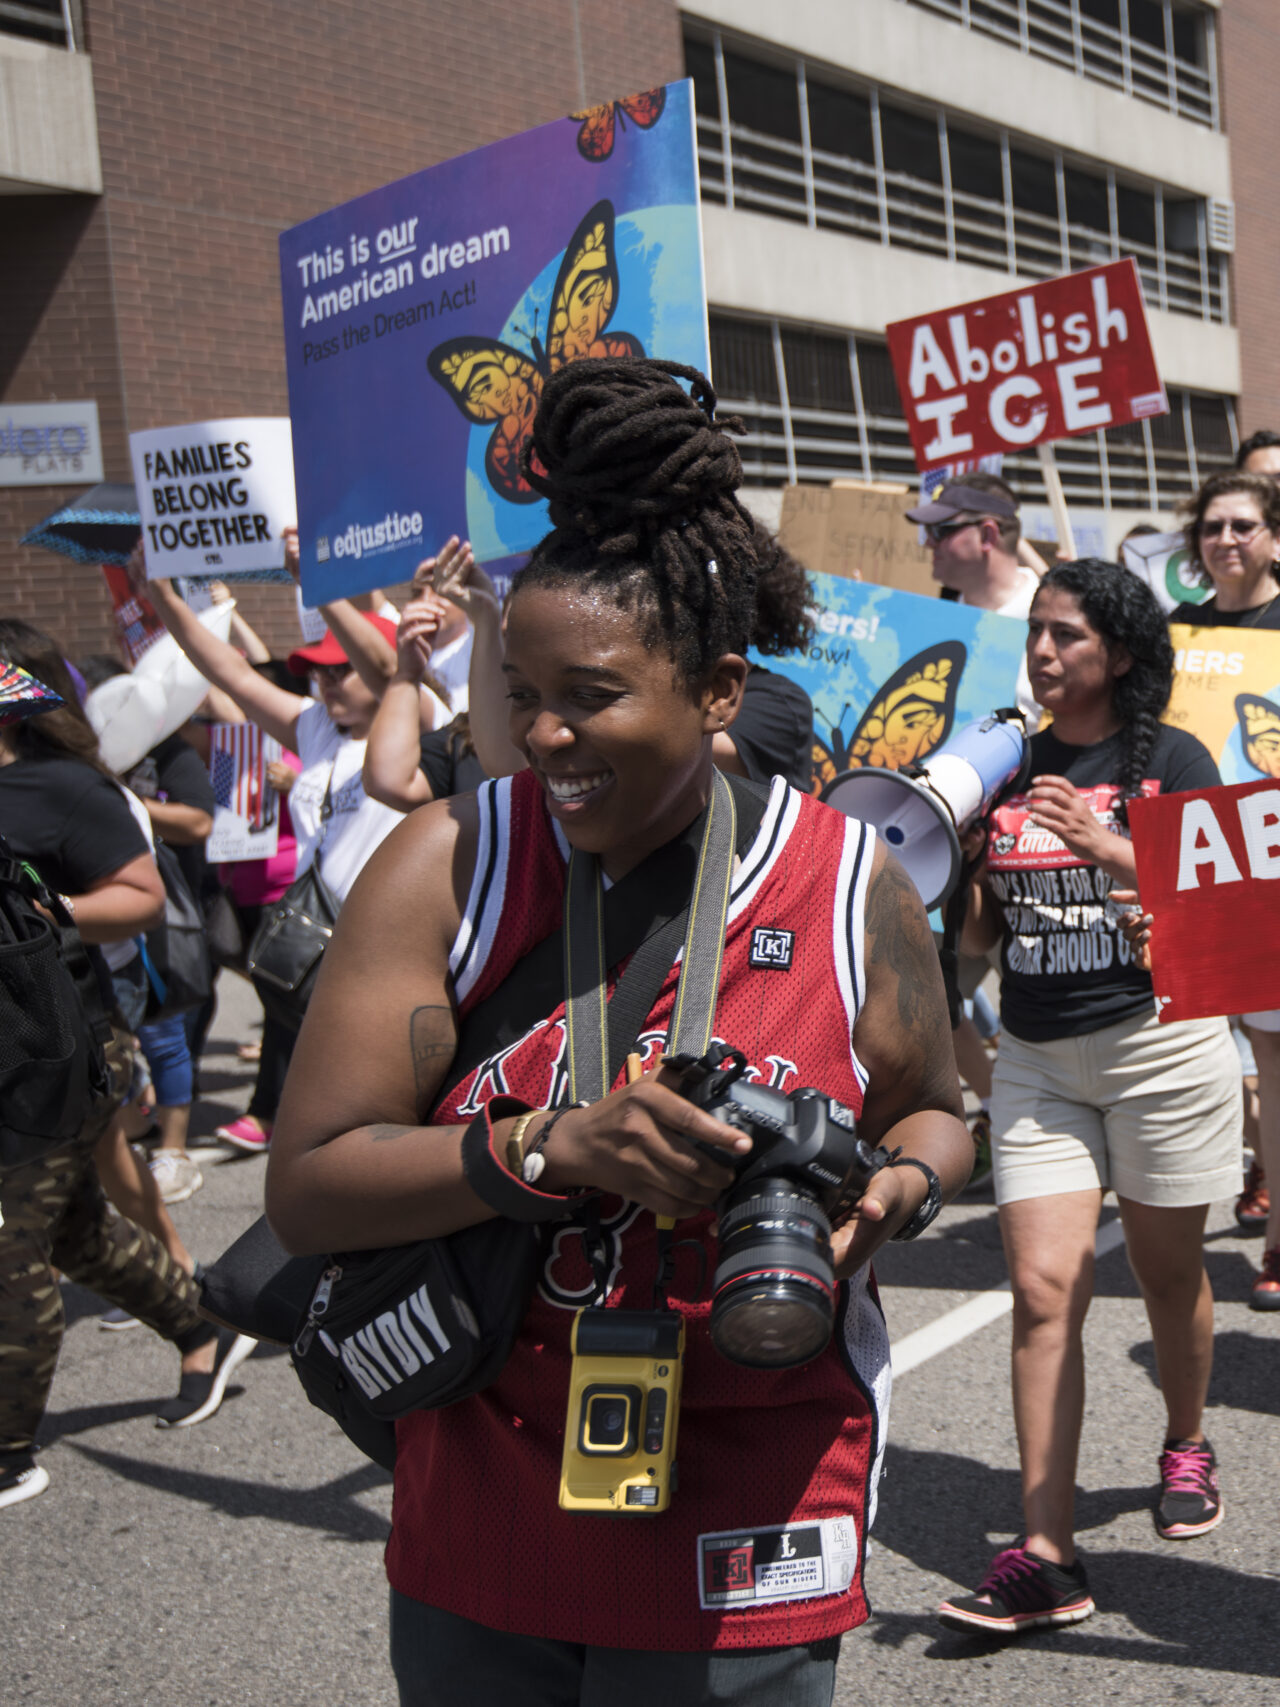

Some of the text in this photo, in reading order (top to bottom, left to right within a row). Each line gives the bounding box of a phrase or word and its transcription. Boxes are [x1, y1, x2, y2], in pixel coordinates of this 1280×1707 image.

[298, 216, 418, 288] This is our
[301, 225, 511, 329] American dream
[303, 279, 477, 366] Pass the Dream Act!
[908, 274, 1129, 399] Abolish
[914, 356, 1113, 462] ICE
[143, 440, 253, 481] FAMILIES
[152, 477, 249, 517] BELONG
[147, 513, 273, 553] TOGETHER
[333, 510, 423, 560] edjustice
[1021, 870, 1062, 905] LOVE
[1061, 867, 1094, 904] FOR
[1064, 905, 1081, 927] AT
[1046, 932, 1114, 975] SHOULD
[808, 1162, 843, 1186] Canon
